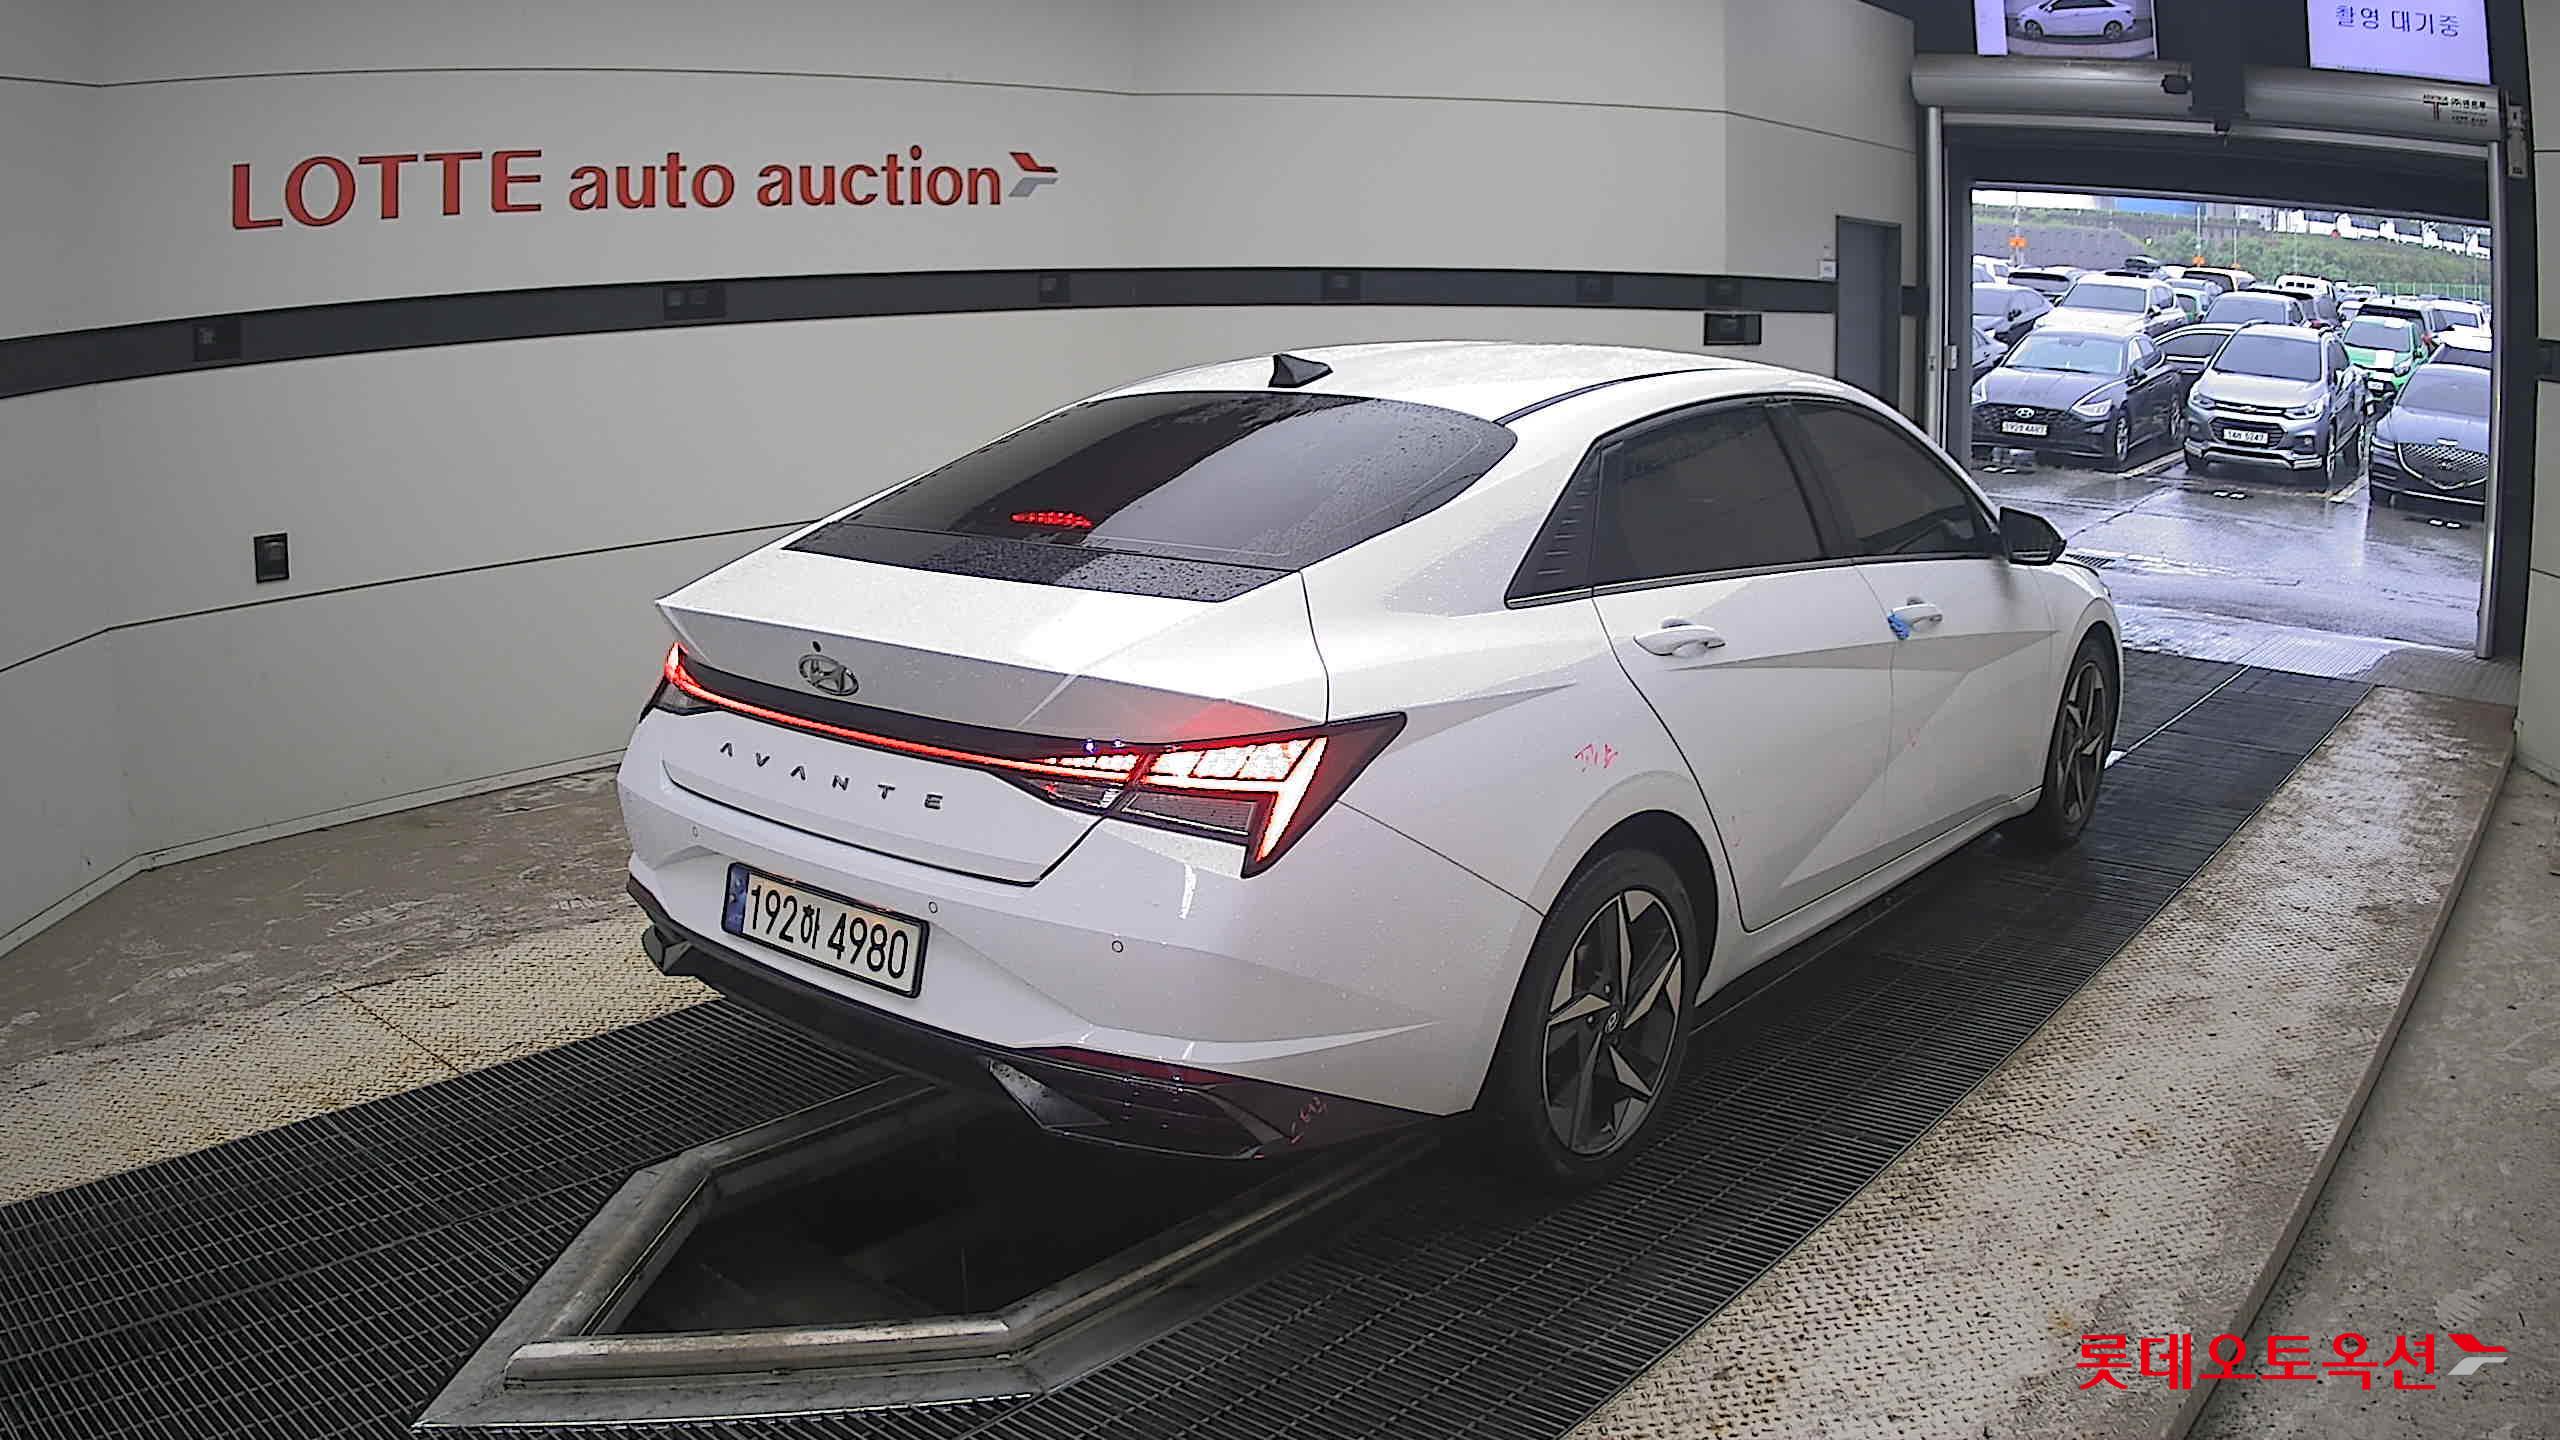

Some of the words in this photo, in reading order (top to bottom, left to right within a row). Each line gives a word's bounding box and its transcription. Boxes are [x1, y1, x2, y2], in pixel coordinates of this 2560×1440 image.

[2336, 5, 2379, 30] 촬영
[2391, 10, 2459, 38] 대기중
[231, 149, 542, 229] LOTTE
[568, 152, 736, 210] auto
[757, 145, 1001, 207] auction
[720, 741, 944, 811] AVANTE
[751, 884, 821, 949] 192하
[827, 912, 909, 979] 4980
